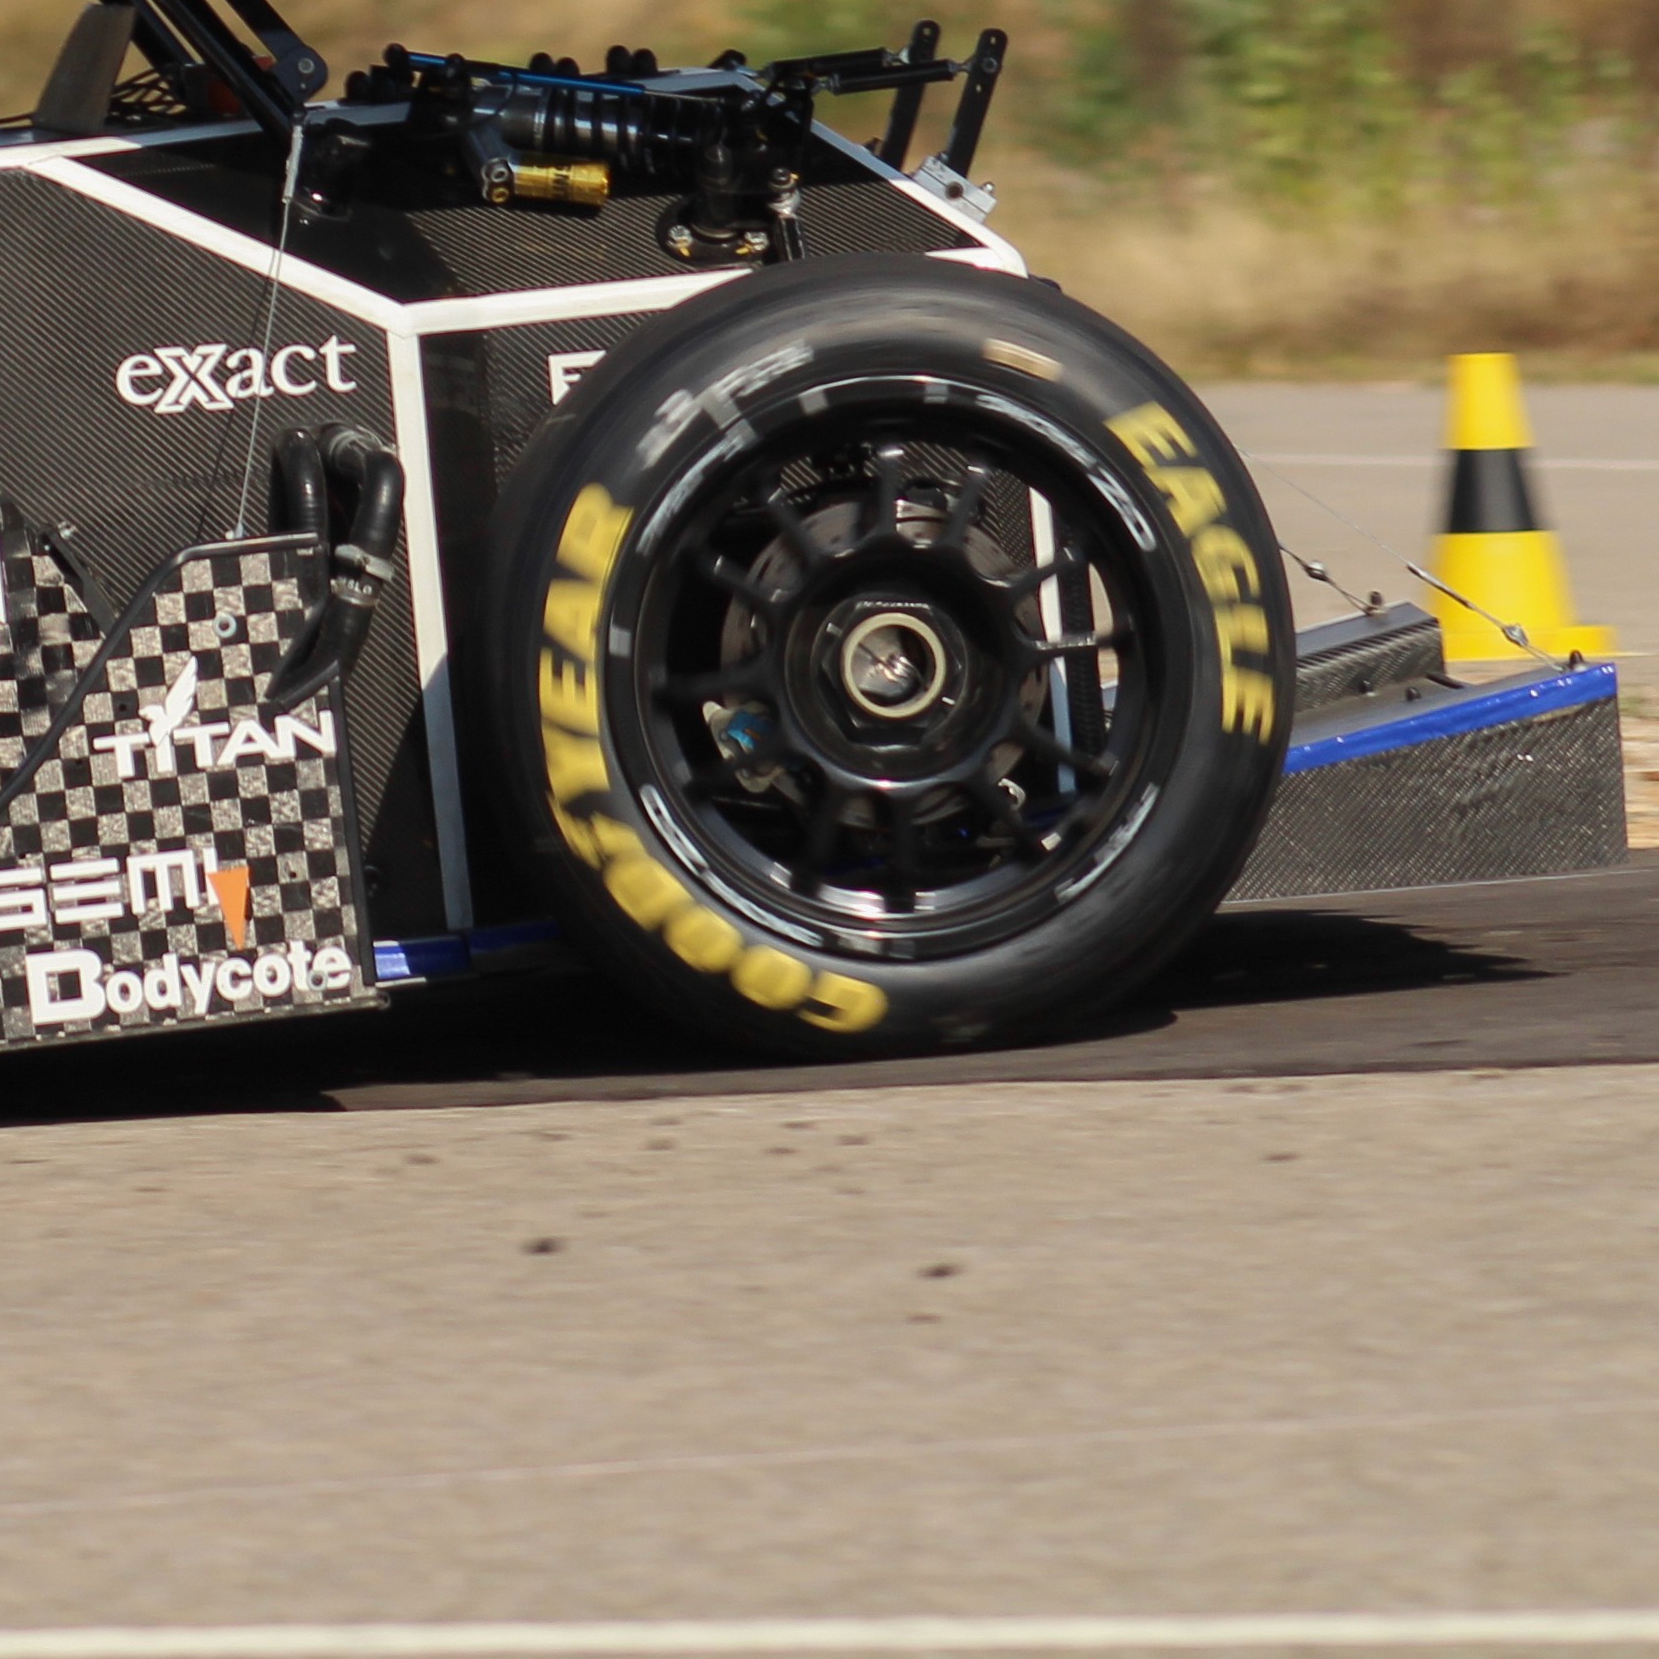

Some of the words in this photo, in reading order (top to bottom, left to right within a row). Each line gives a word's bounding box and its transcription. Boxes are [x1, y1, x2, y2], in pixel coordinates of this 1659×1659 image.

[1105, 401, 1276, 744] EAGLE
[93, 711, 337, 778] TITAN
[25, 940, 353, 1026] Bodycote
